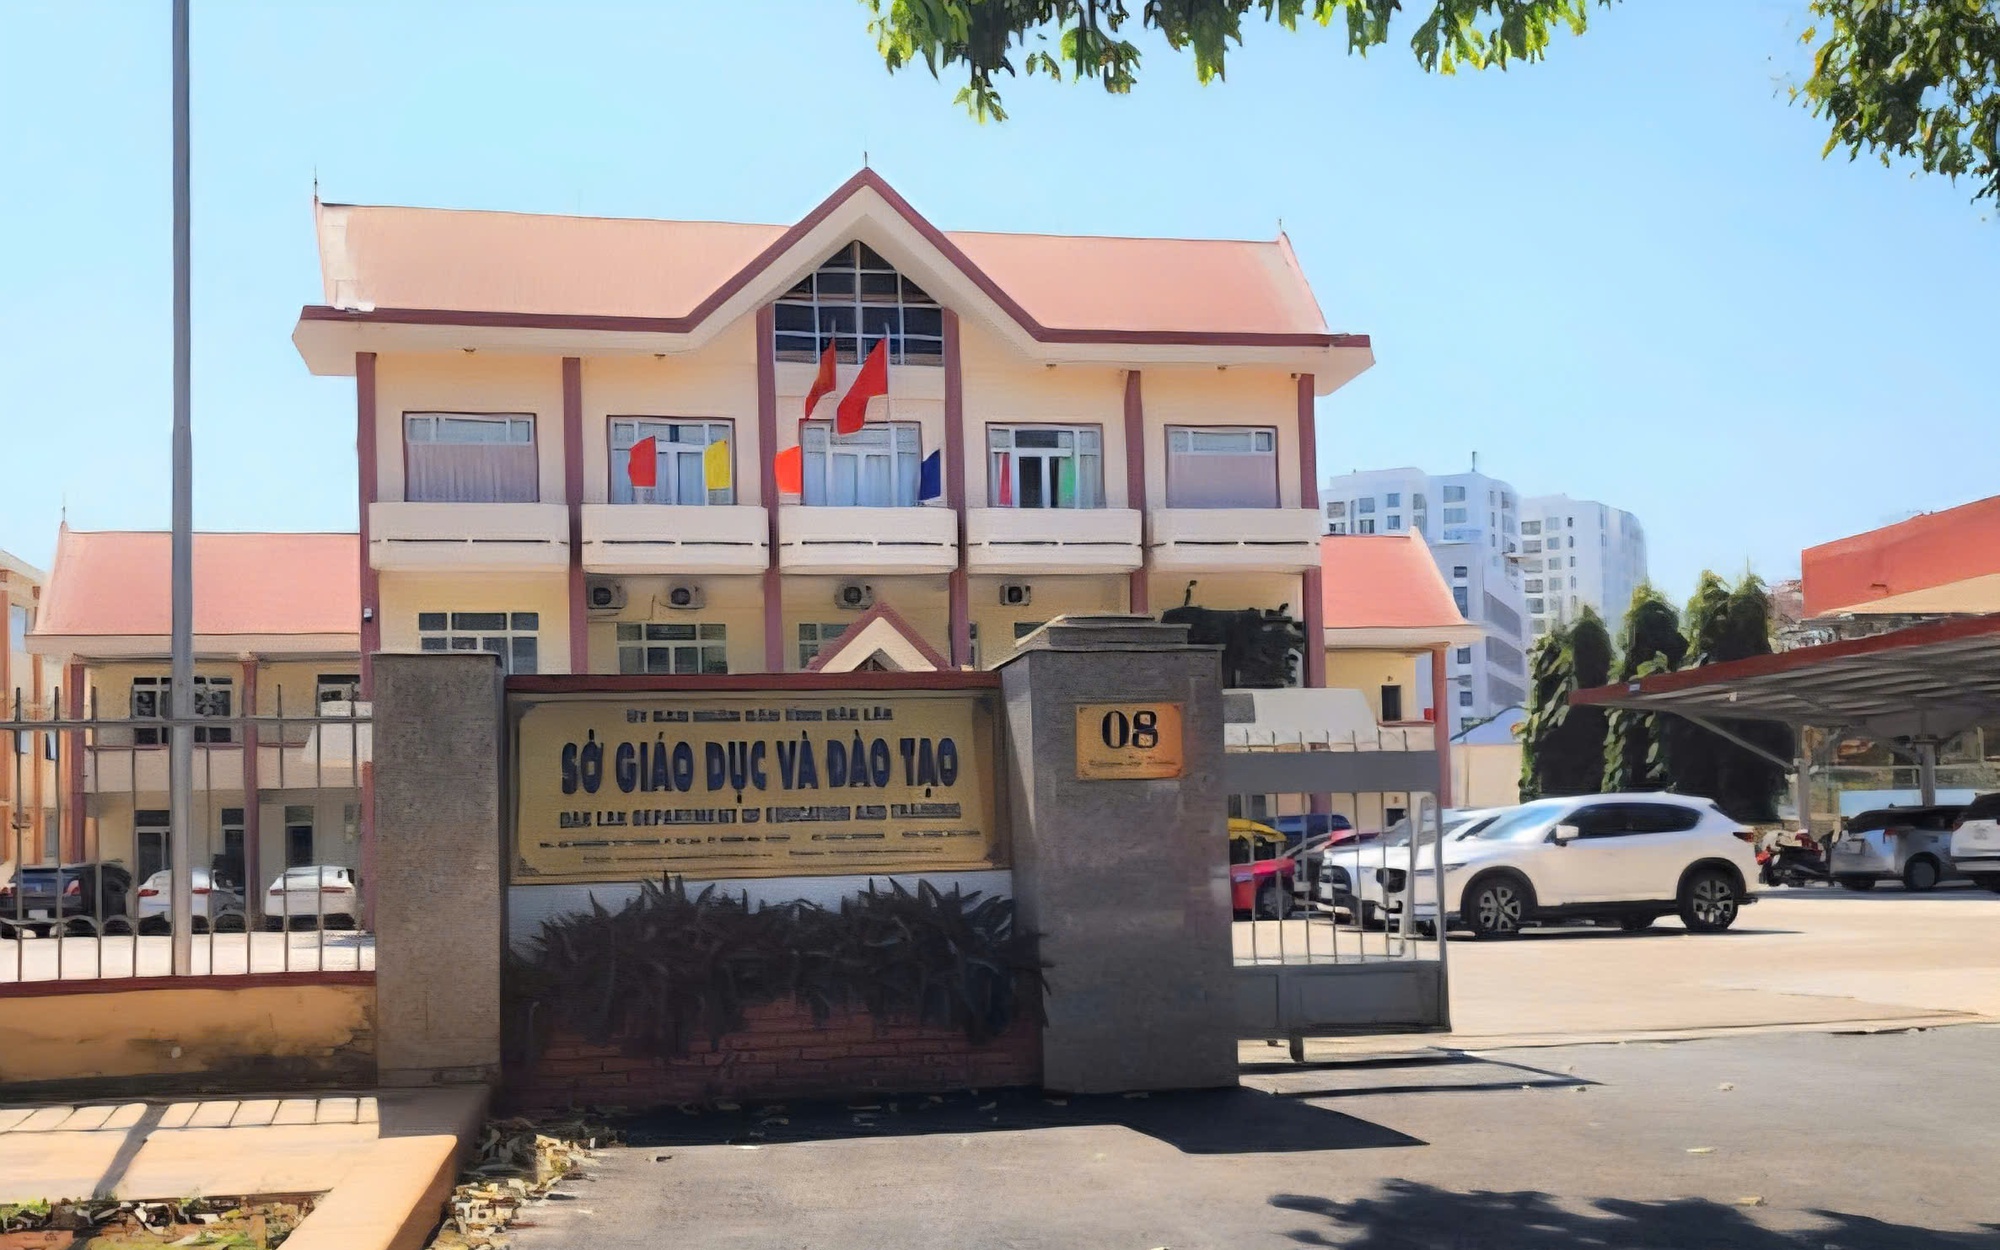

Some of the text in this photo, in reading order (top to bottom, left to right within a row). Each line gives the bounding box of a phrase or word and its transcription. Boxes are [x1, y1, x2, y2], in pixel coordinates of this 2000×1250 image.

[1102, 710, 1158, 749] 08
[616, 731, 694, 794] GIÁO
[705, 740, 767, 804] DỤC
[776, 730, 819, 790] VÀ
[900, 738, 958, 798] TẠO
